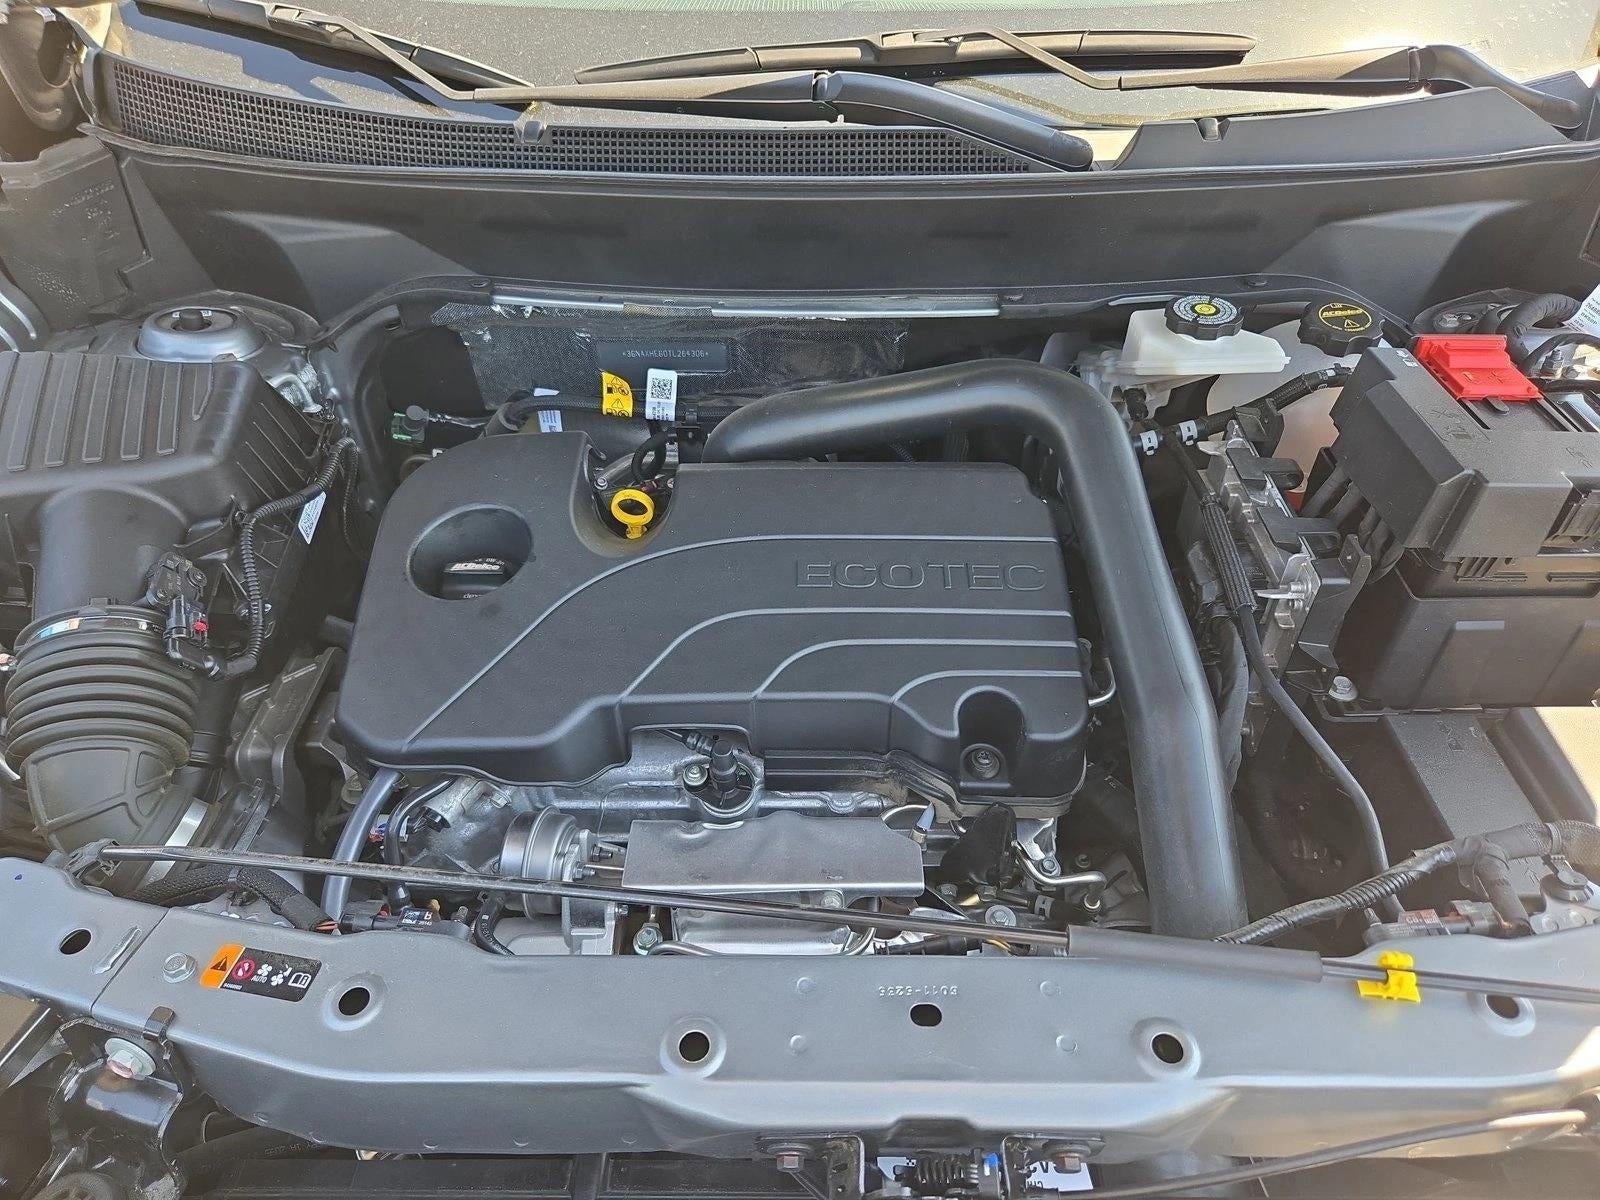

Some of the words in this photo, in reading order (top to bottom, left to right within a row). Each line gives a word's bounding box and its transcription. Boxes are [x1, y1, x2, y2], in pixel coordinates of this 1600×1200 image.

[450, 562, 500, 571] ACDelco
[796, 561, 1046, 591] ECOTEC
[251, 975, 267, 983] AUTO
